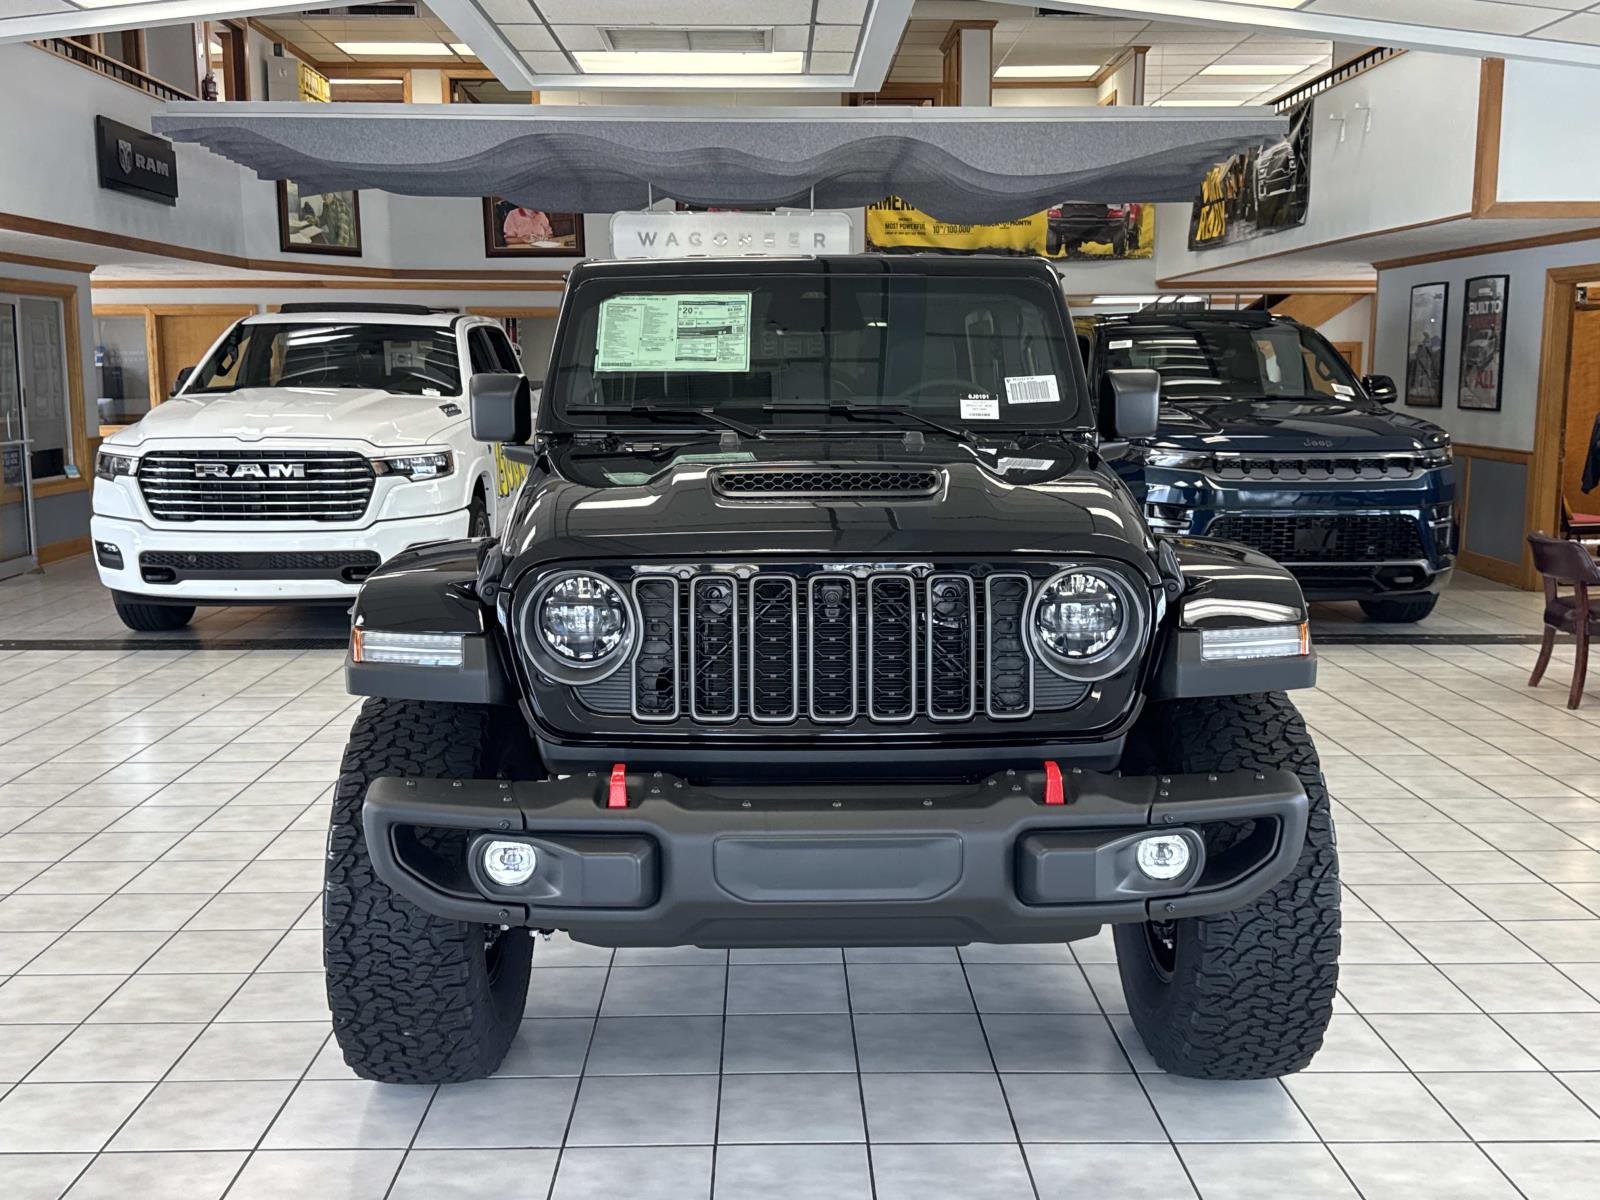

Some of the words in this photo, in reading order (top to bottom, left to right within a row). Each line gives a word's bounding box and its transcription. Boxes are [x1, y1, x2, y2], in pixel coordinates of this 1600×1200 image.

[135, 152, 169, 177] RAM
[637, 231, 827, 248] WAGONEER
[1468, 301, 1490, 316] BUILT
[1490, 299, 1502, 314] TO
[194, 463, 306, 478] RAM
